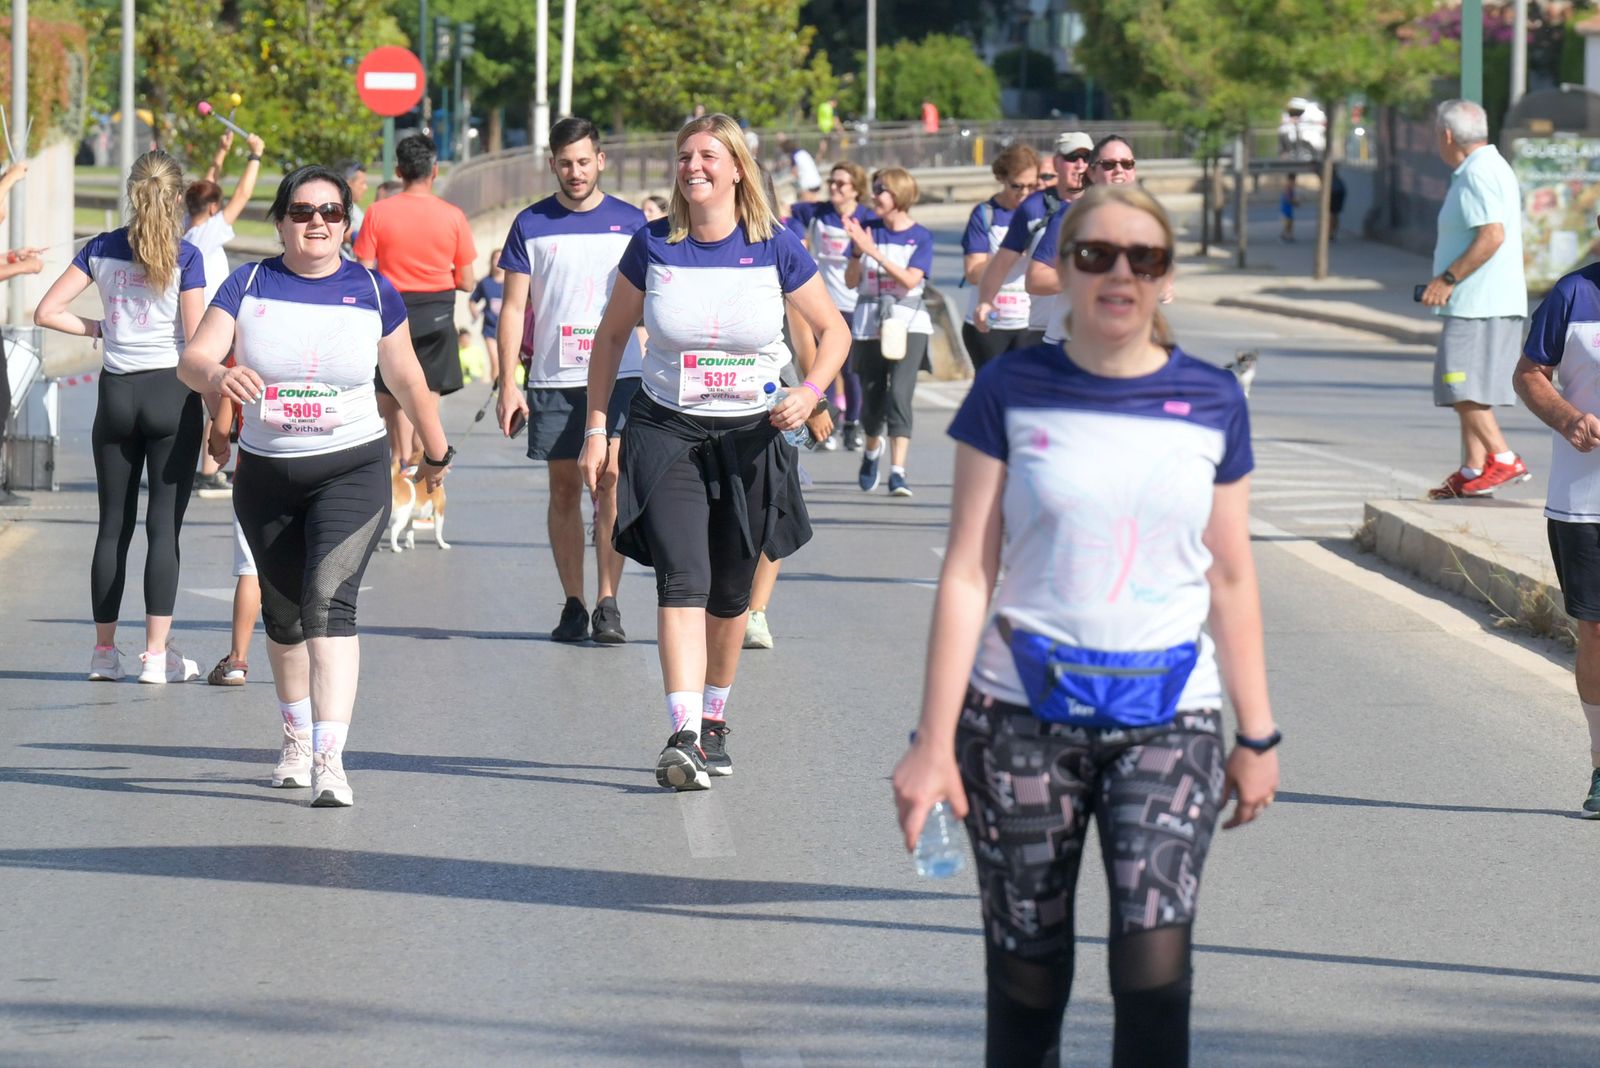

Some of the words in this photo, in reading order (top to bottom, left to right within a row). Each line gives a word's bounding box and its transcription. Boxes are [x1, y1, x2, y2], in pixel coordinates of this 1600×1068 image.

[572, 327, 598, 335] COVI
[704, 372, 737, 387] 5312
[283, 402, 322, 419] 5309
[1183, 715, 1216, 733] FILA
[1155, 812, 1195, 838] FILA
